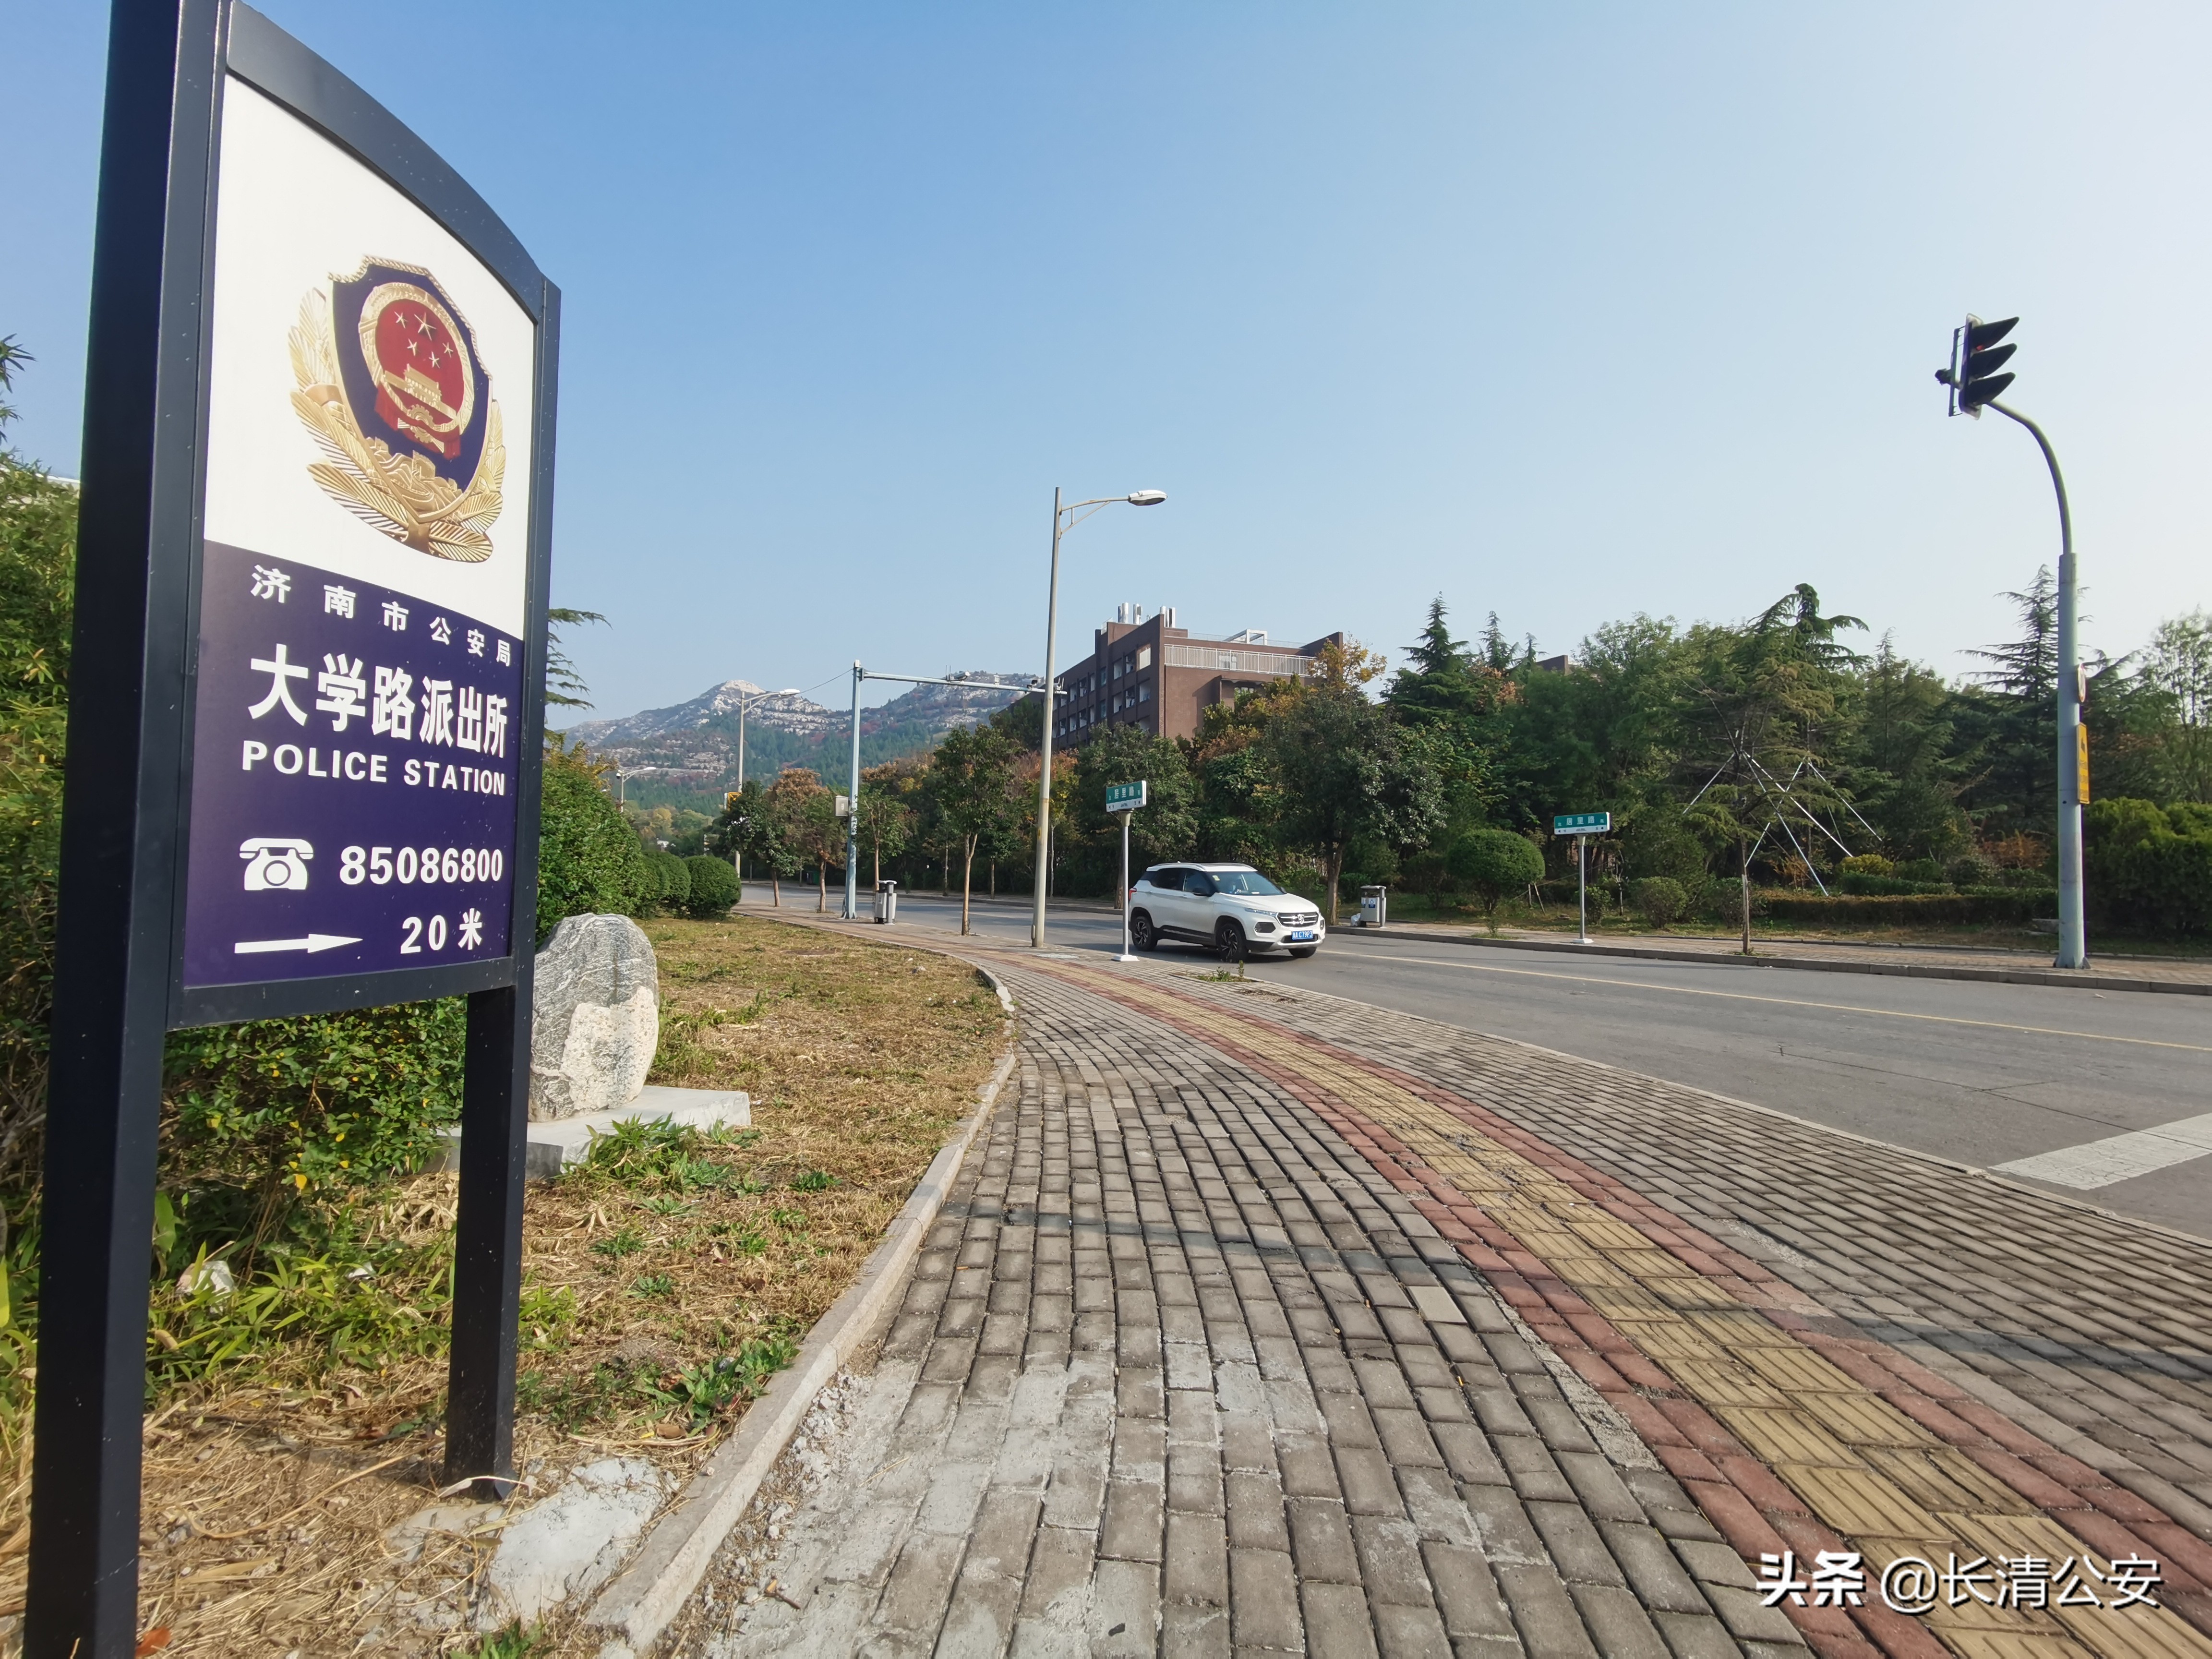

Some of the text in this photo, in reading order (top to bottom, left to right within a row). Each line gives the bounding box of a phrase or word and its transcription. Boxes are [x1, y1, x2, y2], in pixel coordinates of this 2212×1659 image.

[250, 564, 510, 667] 济南市公安局
[248, 643, 507, 758] 大学路派出所
[242, 740, 505, 796] POLICE STATION
[339, 845, 503, 885] 85086800
